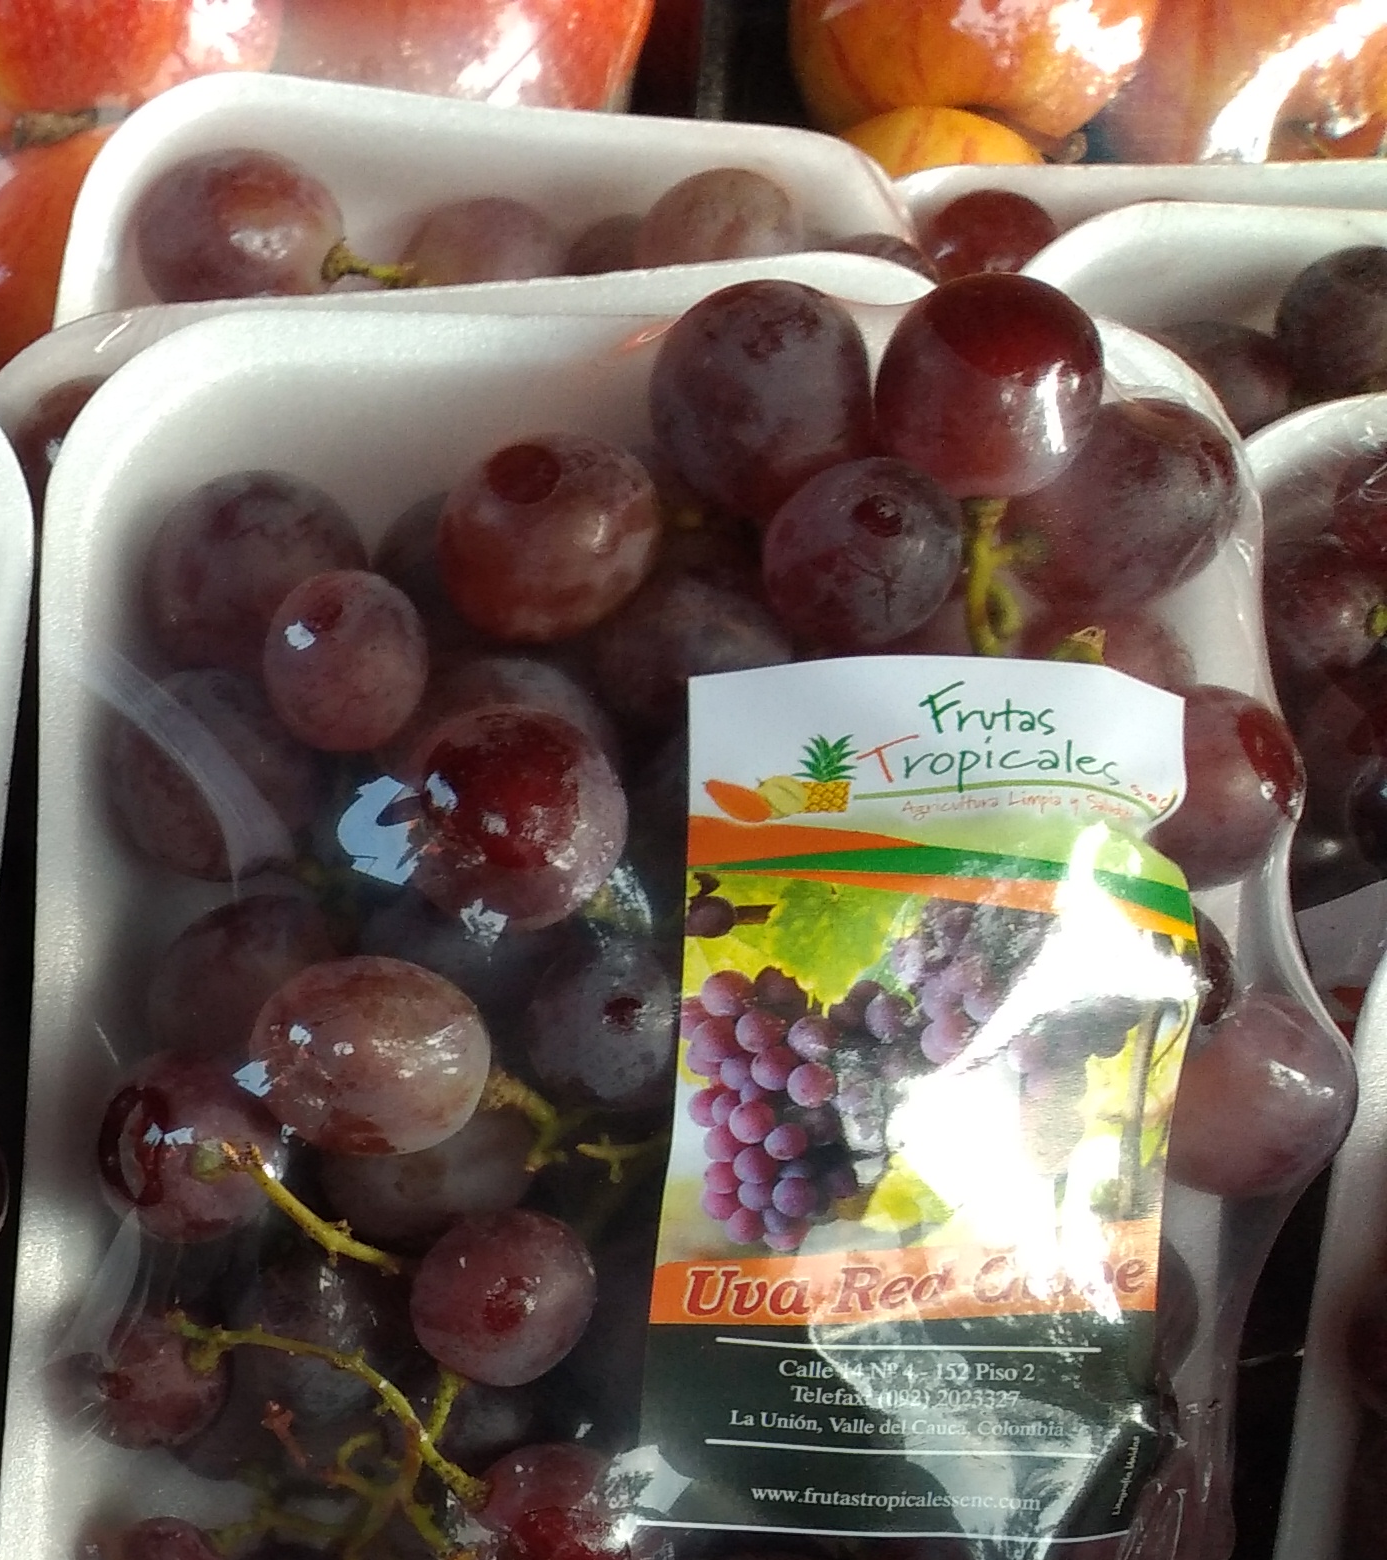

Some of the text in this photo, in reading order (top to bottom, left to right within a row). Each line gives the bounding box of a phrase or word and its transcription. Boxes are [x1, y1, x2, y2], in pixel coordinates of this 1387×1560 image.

[919, 681, 1055, 734] Frutas
[857, 734, 1120, 793] Tropicales
[902, 793, 999, 820] Agricultura
[1008, 791, 1061, 814] Limpia
[683, 1266, 811, 1317] Uva
[830, 1263, 954, 1315] Red
[778, 1359, 833, 1379] Calle
[902, 1363, 916, 1380] 4
[935, 1363, 969, 1381] 152
[975, 1363, 1017, 1382] Piso
[1022, 1363, 1036, 1381] 2
[729, 1410, 1064, 1437] La Unión, Valle del Cauca, Colombia
[751, 1487, 1041, 1512] www.frutastropicalessenc.com
